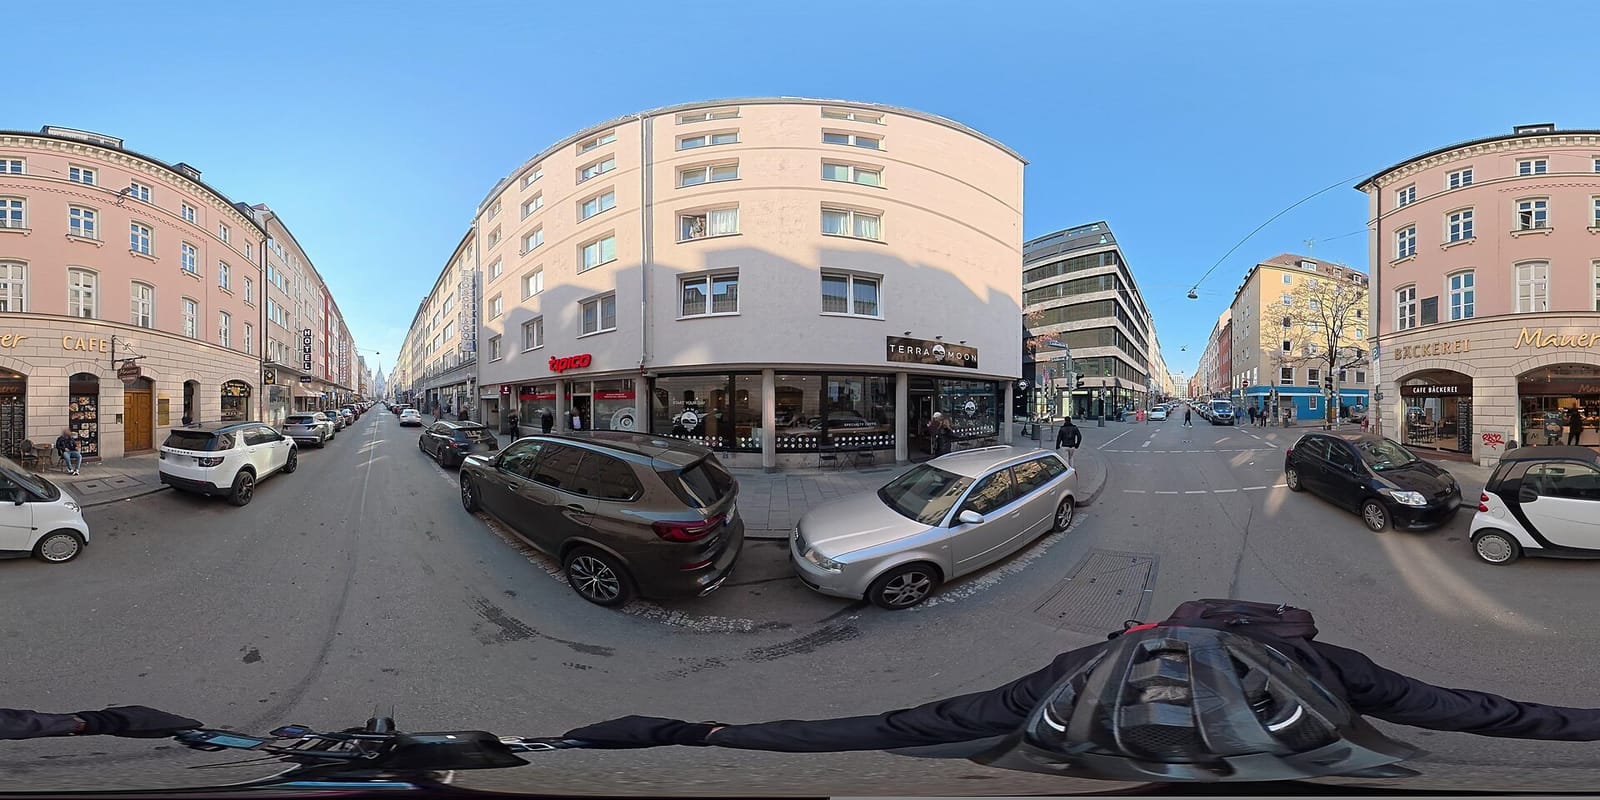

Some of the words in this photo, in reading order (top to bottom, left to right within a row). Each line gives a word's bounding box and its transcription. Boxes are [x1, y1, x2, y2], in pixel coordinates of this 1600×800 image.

[0, 333, 27, 348] er
[62, 335, 108, 353] CAFE
[303, 329, 311, 370] HOTEL
[889, 344, 930, 356] TERRA
[947, 351, 977, 362] MOON
[548, 353, 592, 374] tipico
[1412, 386, 1426, 394] CAFE
[1428, 385, 1458, 393] BÄCKEREI
